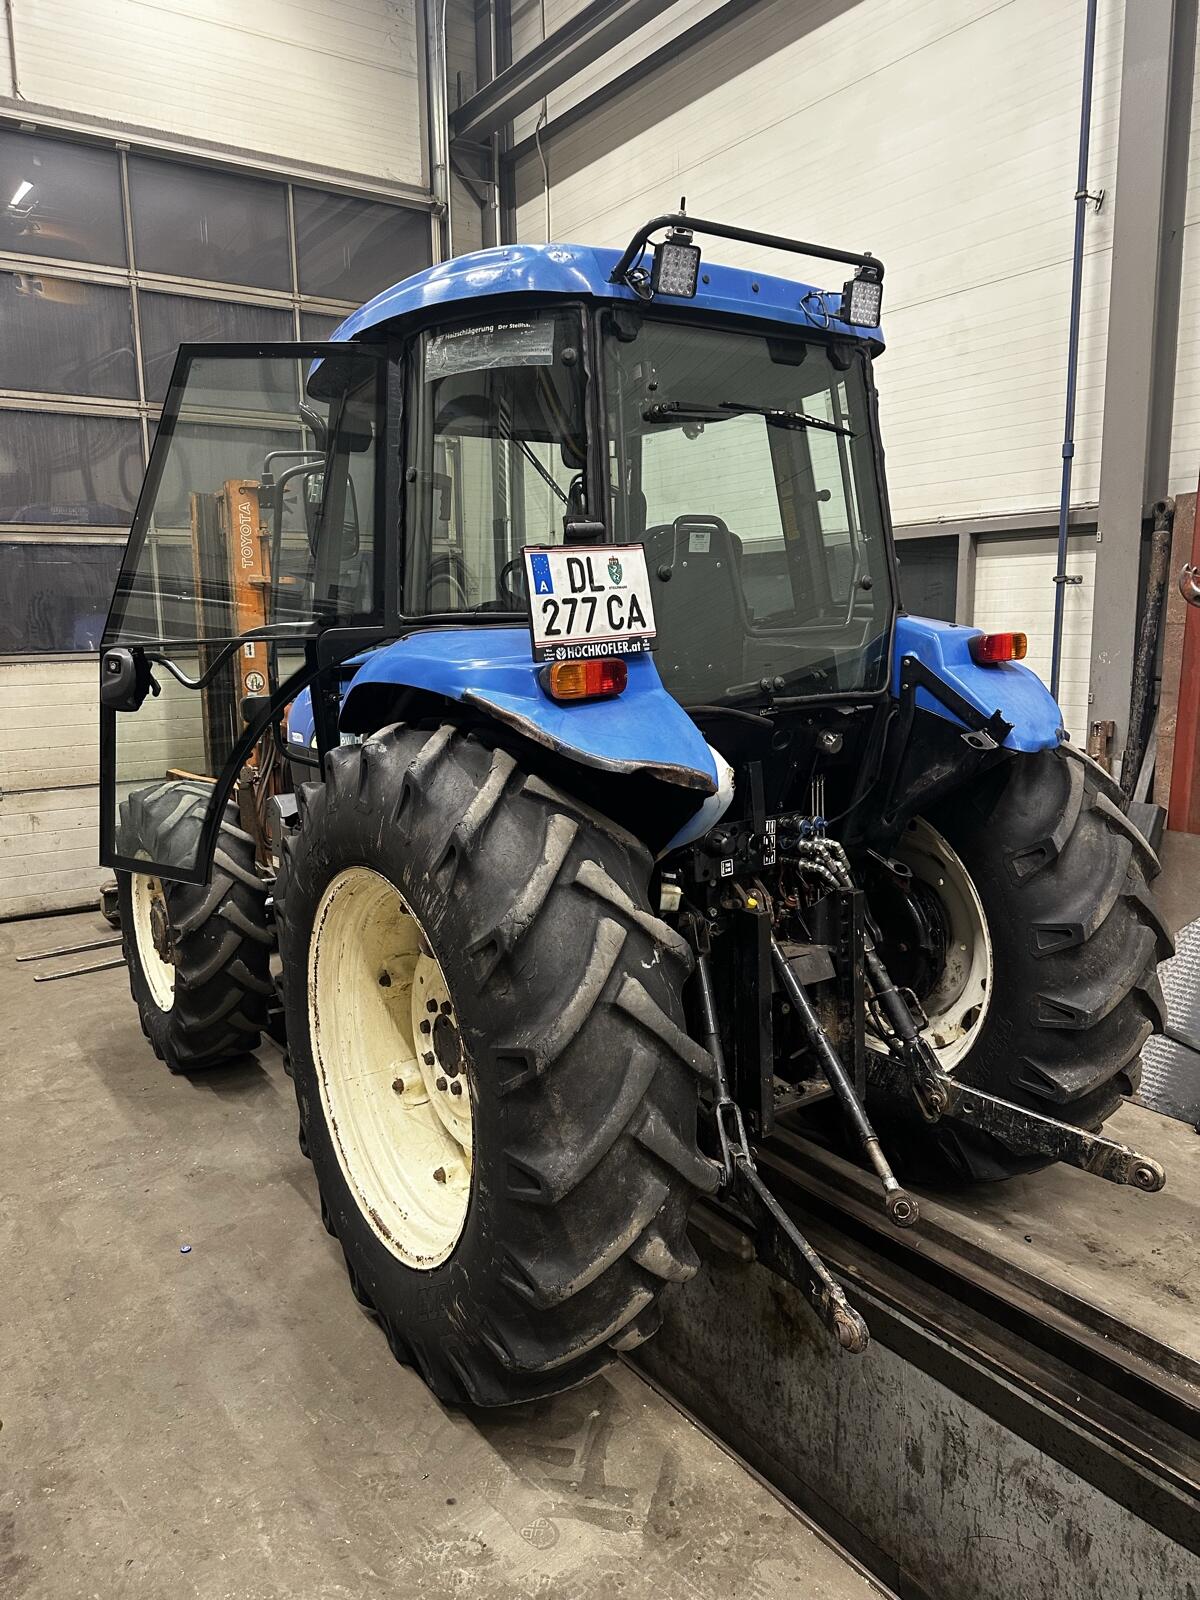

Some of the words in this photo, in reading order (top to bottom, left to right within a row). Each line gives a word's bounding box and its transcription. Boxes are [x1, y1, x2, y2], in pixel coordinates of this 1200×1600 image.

[238, 502, 253, 568] TOYOTA
[540, 581, 549, 592] A
[566, 556, 605, 593] DL
[542, 597, 597, 635] 277
[607, 594, 646, 630] CA
[567, 641, 641, 658] HOCHKOFLER.at
